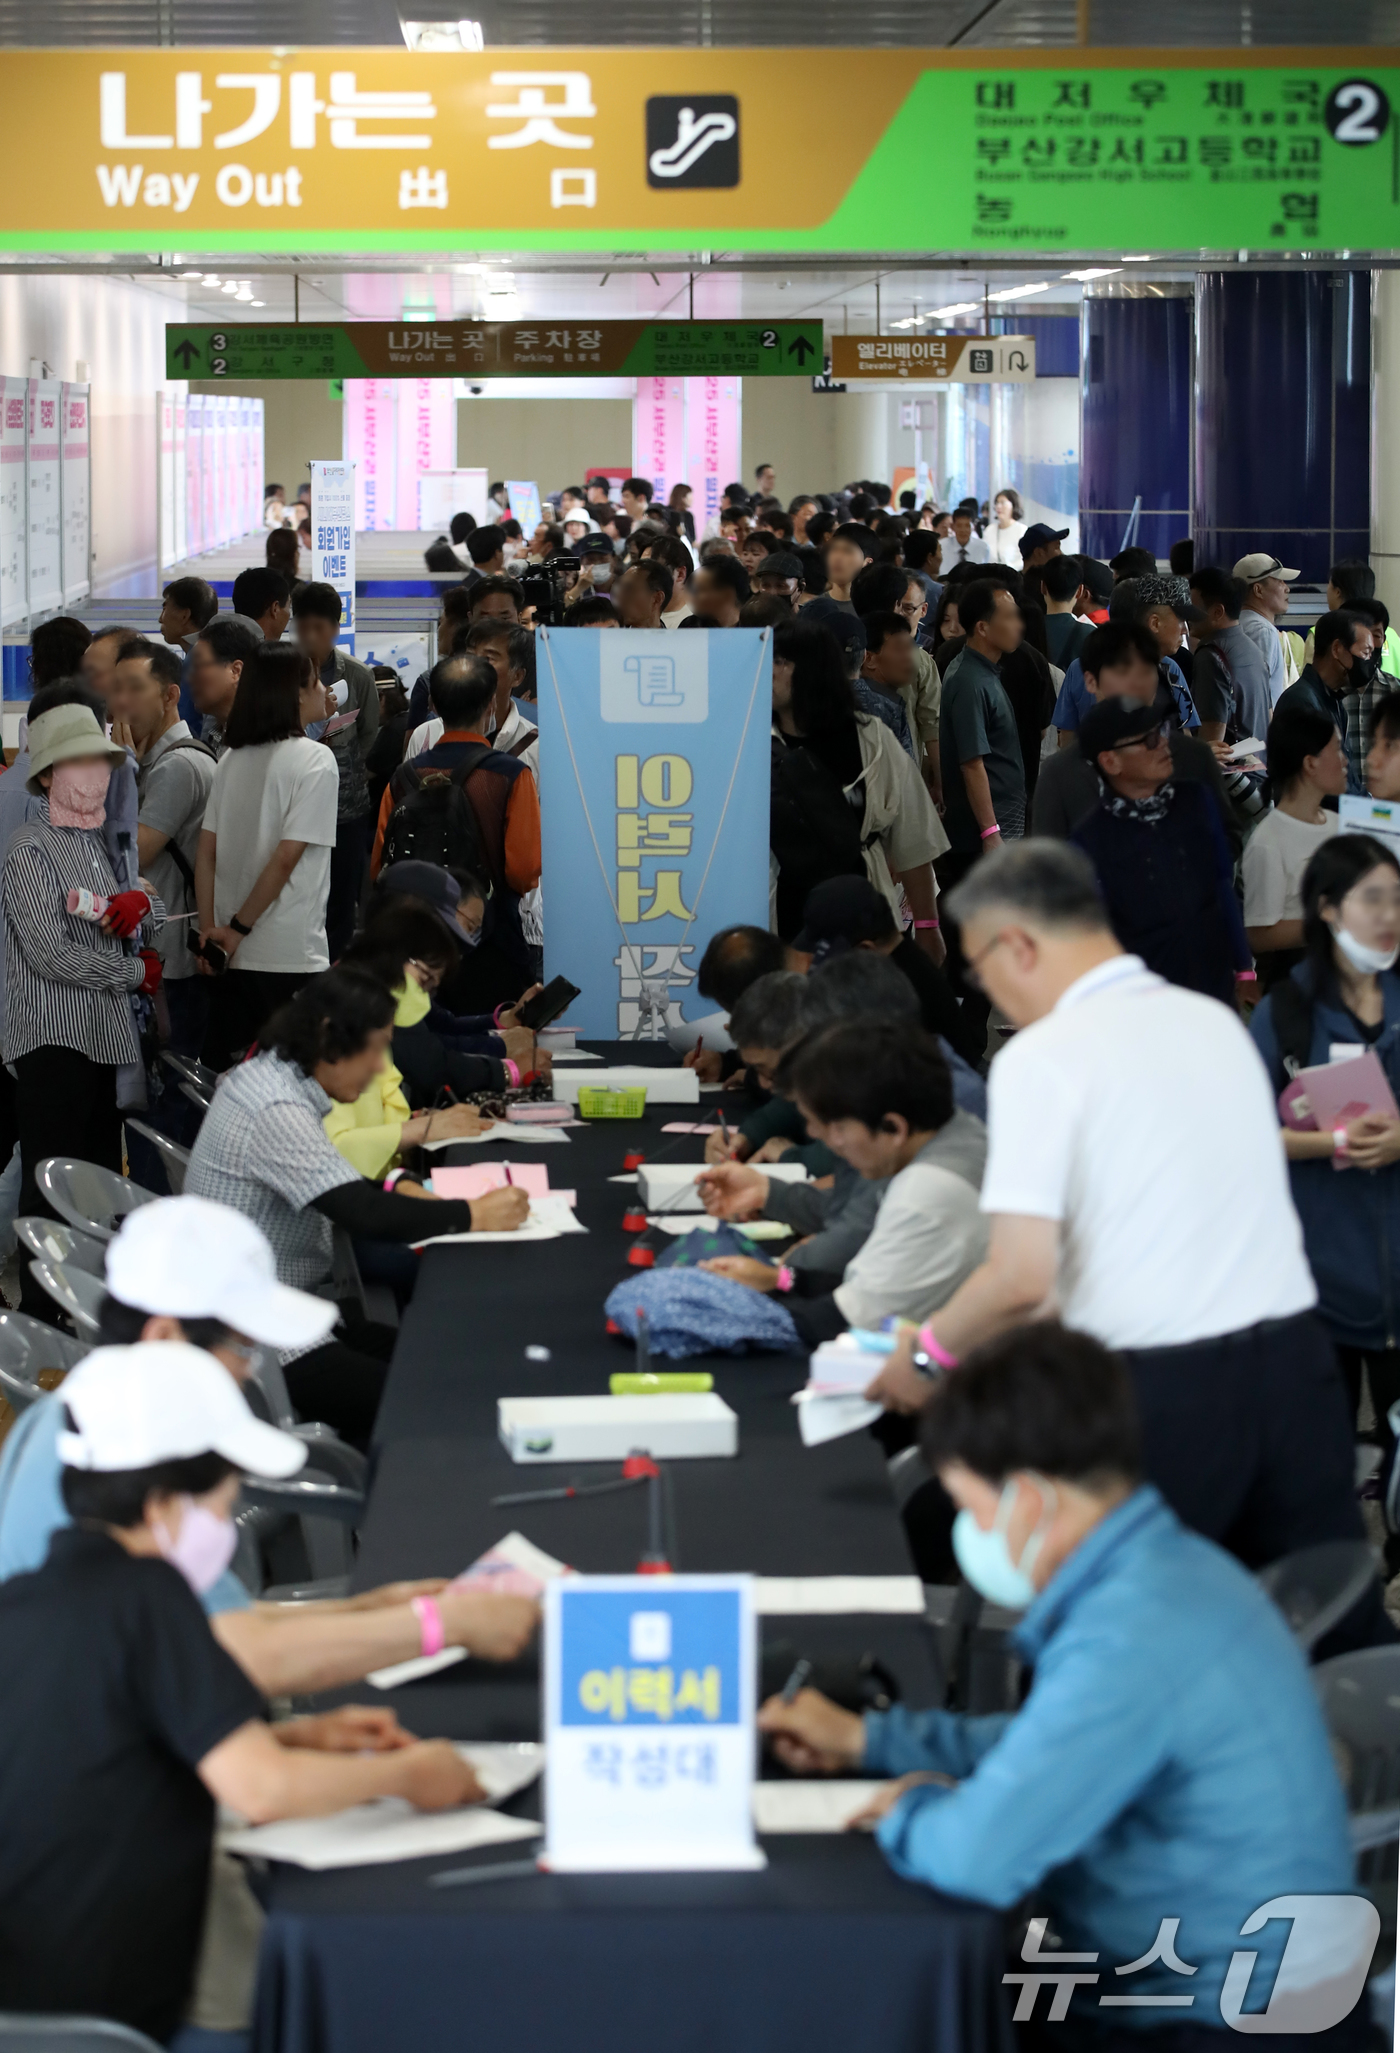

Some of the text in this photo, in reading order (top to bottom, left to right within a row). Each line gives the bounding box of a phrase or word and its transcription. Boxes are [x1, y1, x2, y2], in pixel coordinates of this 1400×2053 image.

[975, 80, 1321, 111] 대저우체국
[100, 71, 596, 149] 나가는 곳
[1335, 84, 1380, 142] 2
[975, 136, 1322, 167] 부산강서고등학교
[97, 165, 302, 212] Way Out
[213, 334, 227, 350] 3
[388, 331, 484, 349] 나가는 곳
[514, 330, 603, 349] 주차장
[762, 332, 776, 347] 2
[389, 352, 435, 363] Way Out
[514, 353, 554, 363] Parking
[857, 343, 947, 359] 엘리베이터
[213, 358, 227, 374] 2
[858, 362, 897, 370] Elevator
[318, 526, 350, 551] 회원가입
[323, 555, 346, 578] 이벤트
[579, 1665, 721, 1722] 이력서
[584, 1740, 717, 1788] 작성대
